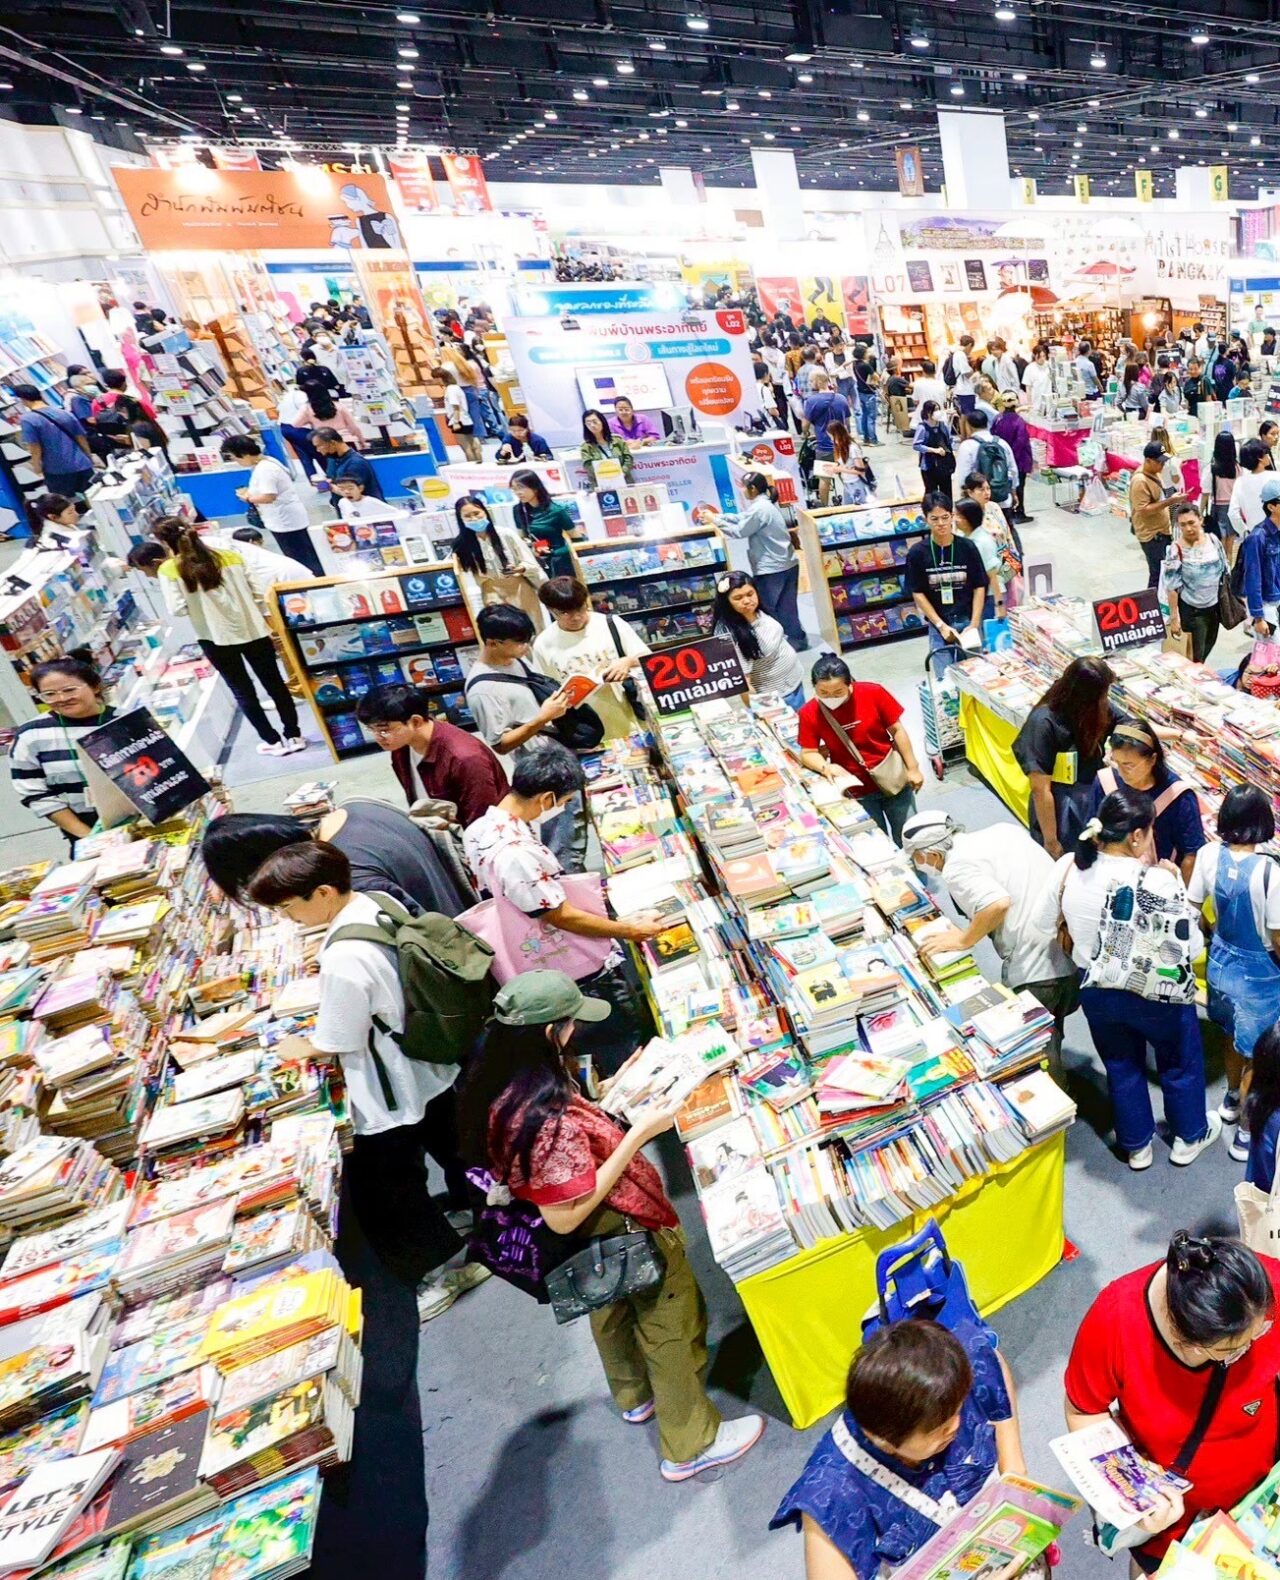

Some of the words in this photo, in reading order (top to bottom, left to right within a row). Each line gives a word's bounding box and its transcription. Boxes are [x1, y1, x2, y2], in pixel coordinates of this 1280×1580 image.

[1141, 179, 1147, 193] F
[1214, 175, 1222, 192] G
[1097, 597, 1139, 630] 20
[1138, 609, 1160, 620] บาท
[1103, 620, 1164, 650] ทุกเล่มค่ะ
[646, 648, 706, 689] 20
[707, 658, 737, 672] บาท
[657, 671, 743, 710] ทุกเล่มค่ะ
[1269, 1230, 1274, 1239] I
